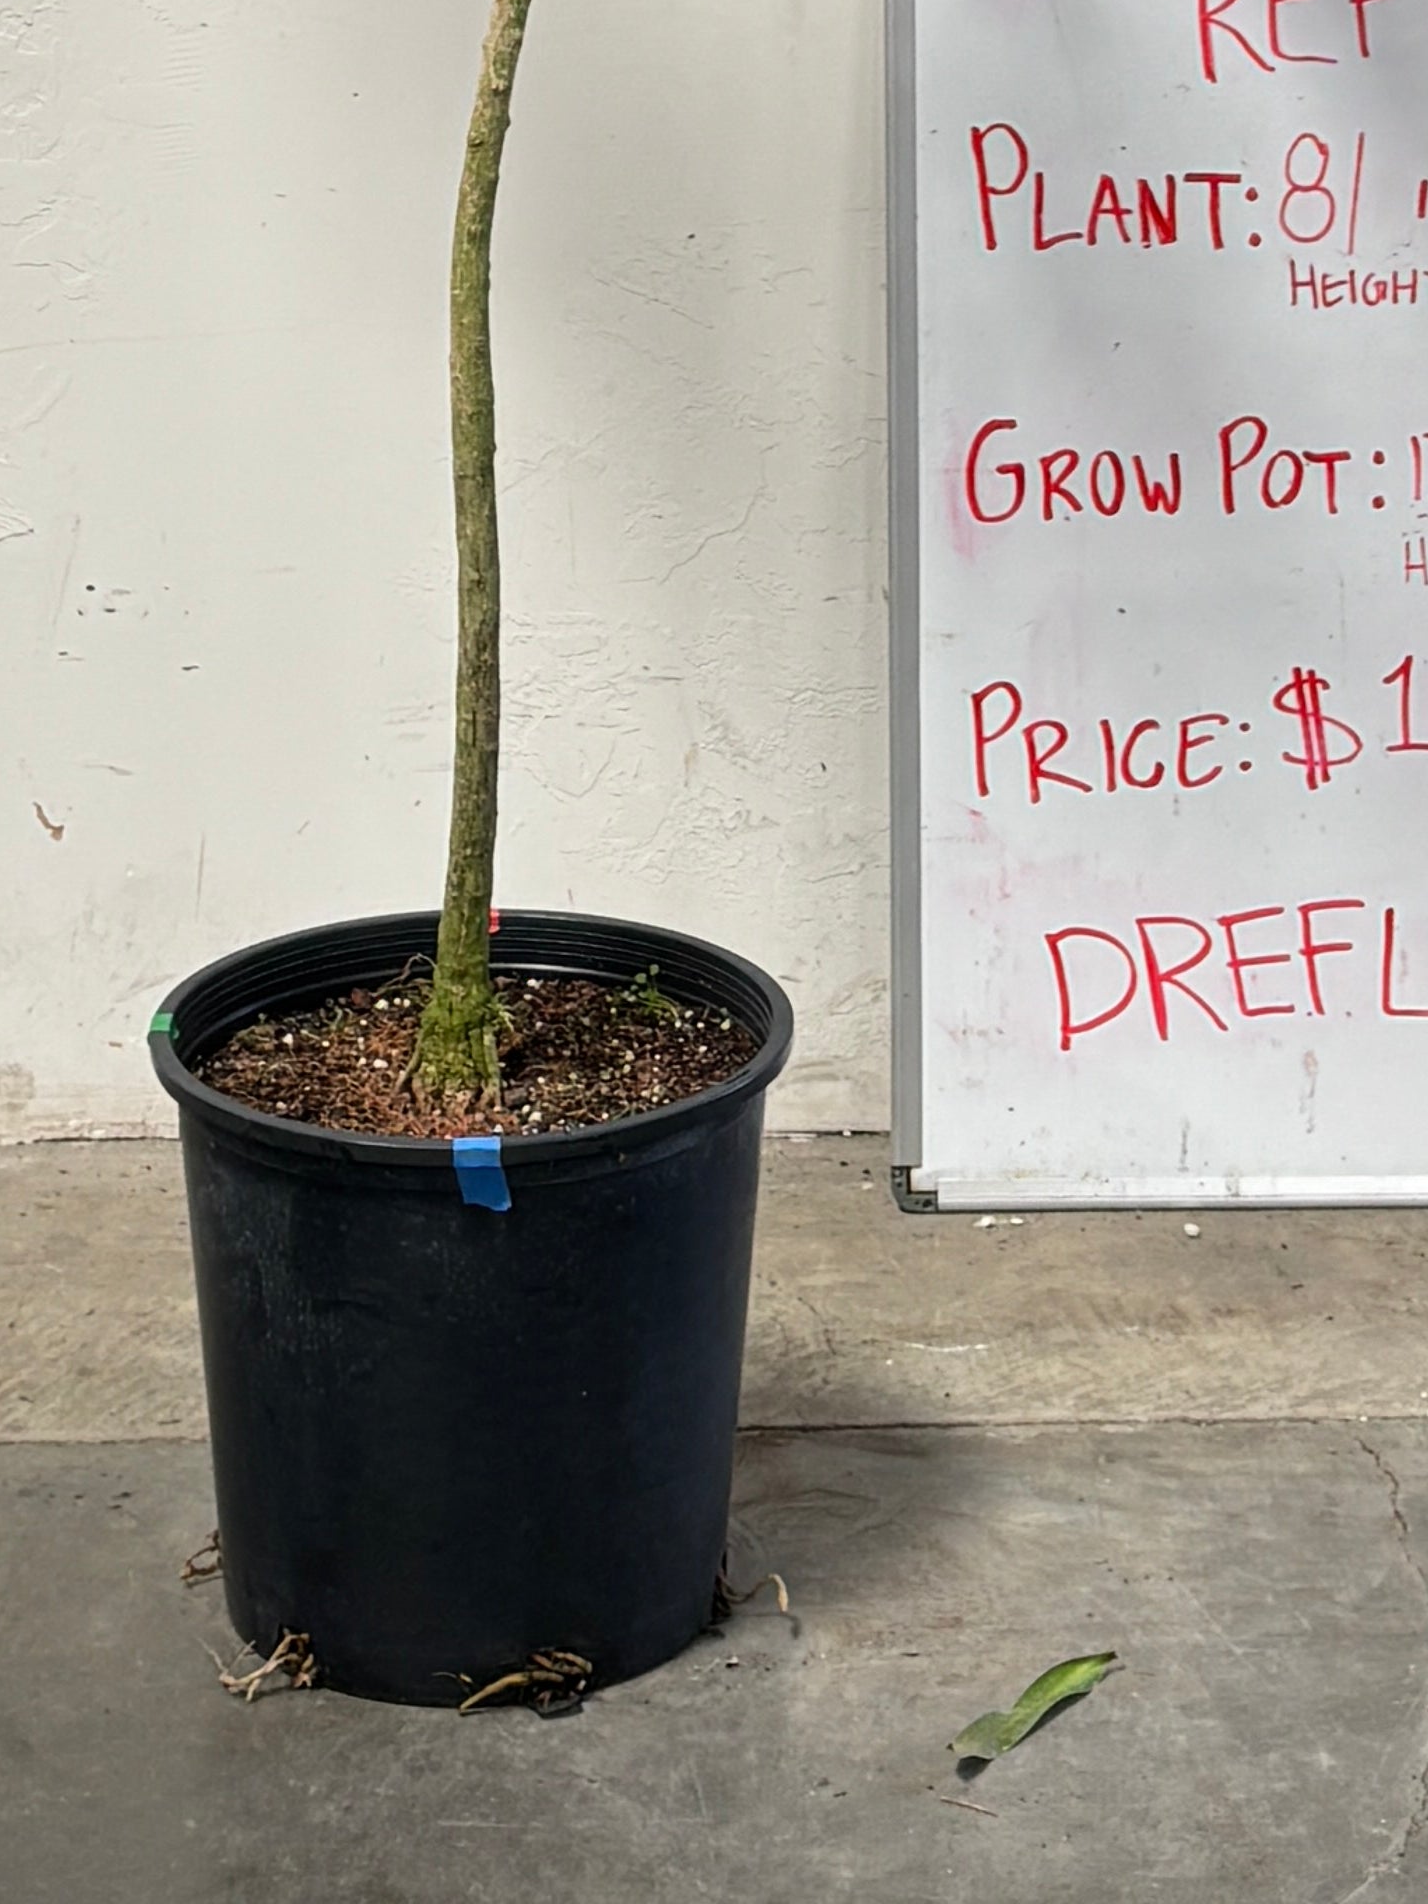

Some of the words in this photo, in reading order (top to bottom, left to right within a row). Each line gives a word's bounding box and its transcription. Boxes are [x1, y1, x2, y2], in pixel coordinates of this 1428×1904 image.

[1278, 132, 1365, 254] 81
[964, 418, 1182, 525] GROW
[1217, 415, 1386, 513] POT:
[971, 680, 1252, 804] PRICE:
